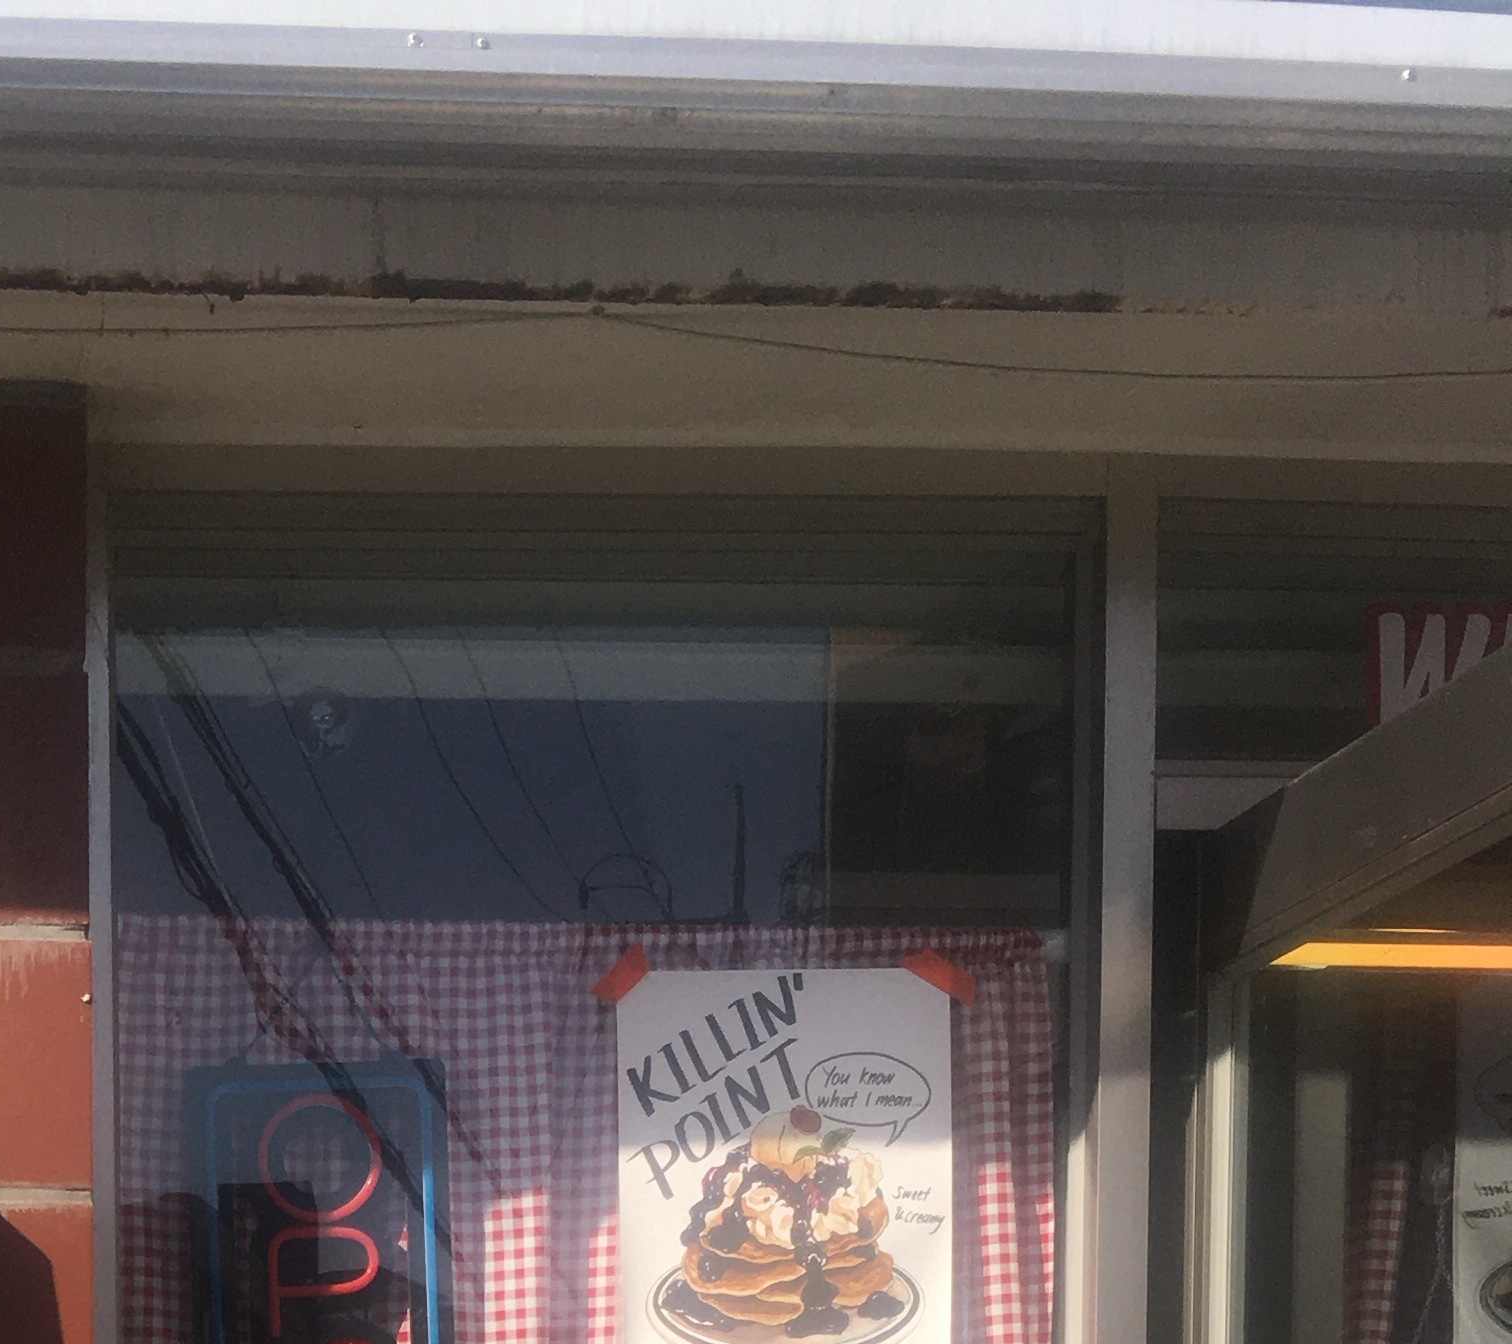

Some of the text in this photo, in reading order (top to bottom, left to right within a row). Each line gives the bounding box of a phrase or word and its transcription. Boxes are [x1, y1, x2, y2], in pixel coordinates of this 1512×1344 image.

[626, 972, 804, 1117] KILLIN'
[822, 1065, 895, 1088] You know
[817, 1089, 858, 1108] what
[865, 1091, 872, 1107] I
[627, 1038, 801, 1200] POINT
[891, 1185, 932, 1201] Sweet
